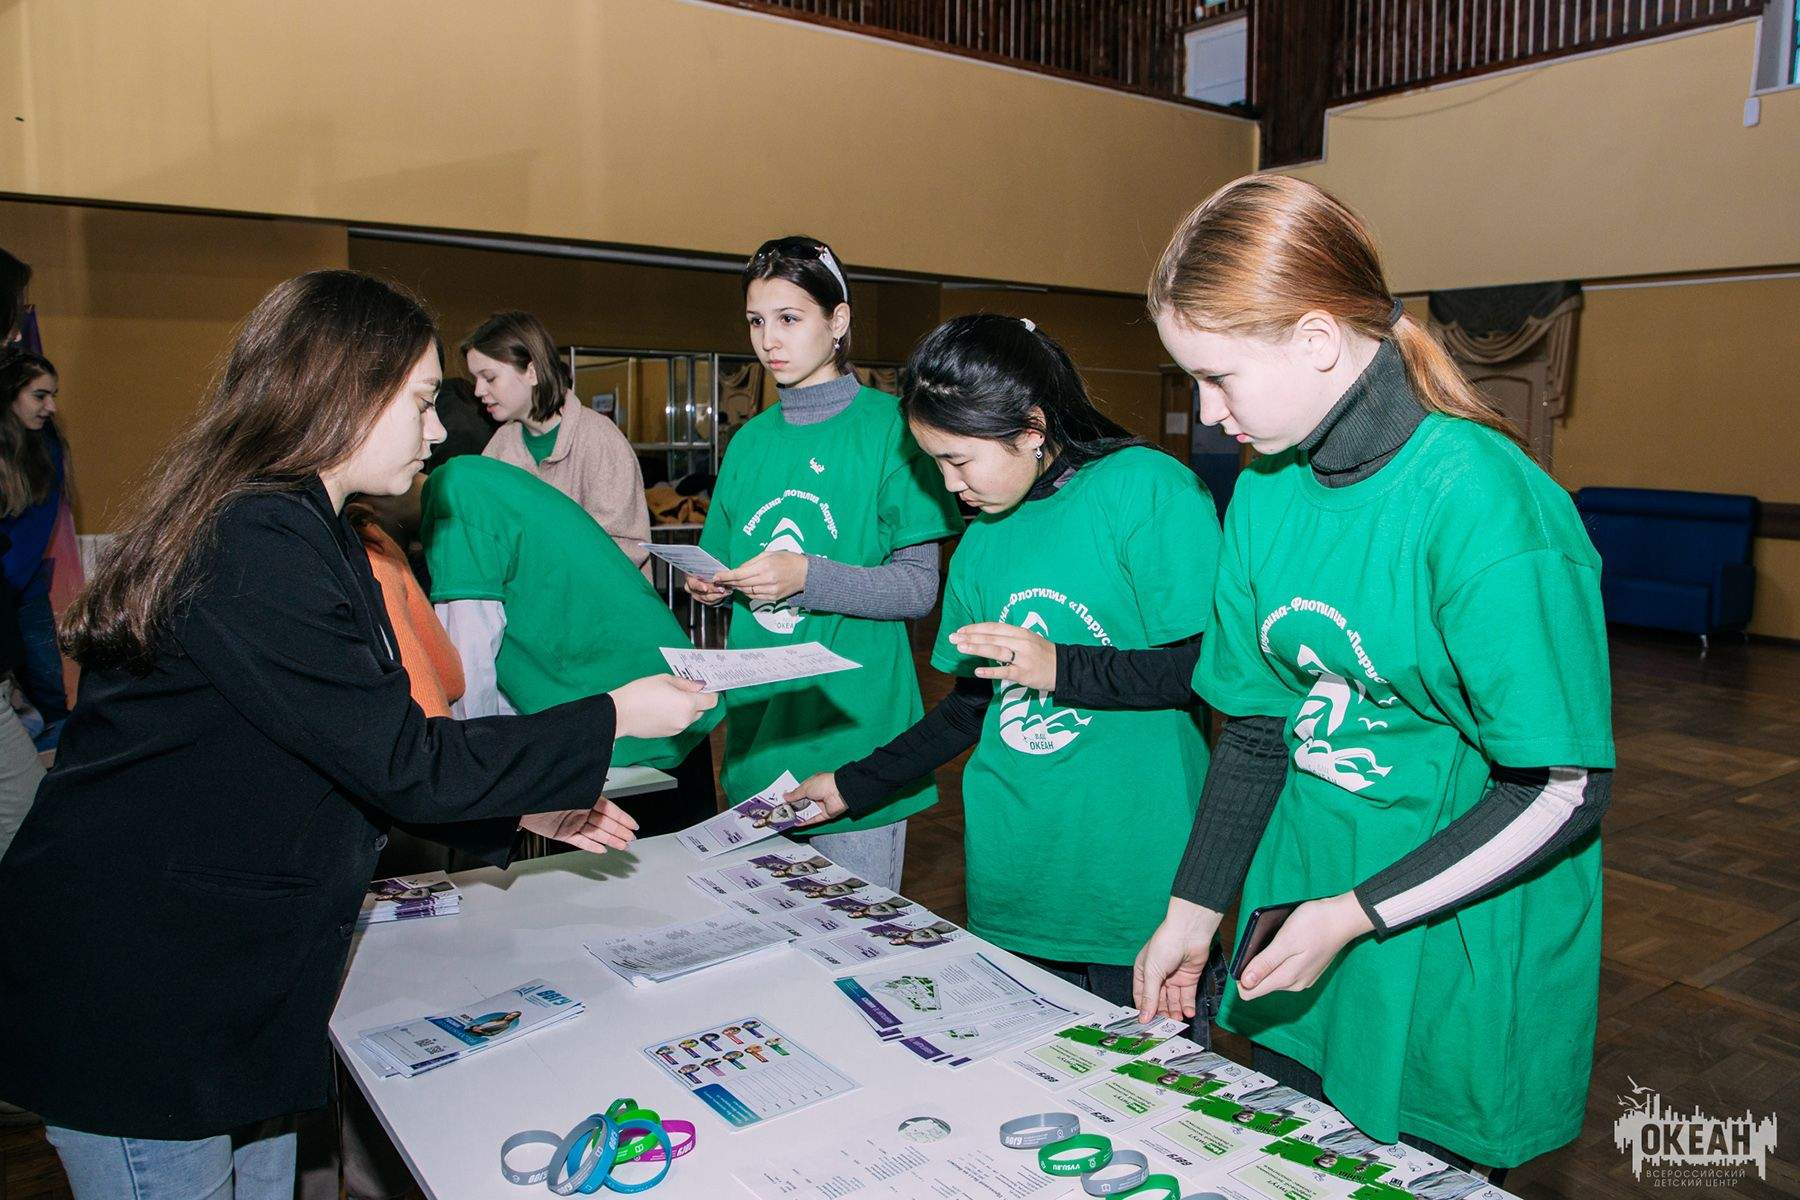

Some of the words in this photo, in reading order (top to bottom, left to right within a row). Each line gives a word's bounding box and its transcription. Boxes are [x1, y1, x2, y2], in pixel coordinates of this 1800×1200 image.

[1069, 603, 1113, 646] «Парус
[1030, 741, 1054, 750] ОКЕАН
[1052, 1163, 1081, 1171] VVSU.RU
